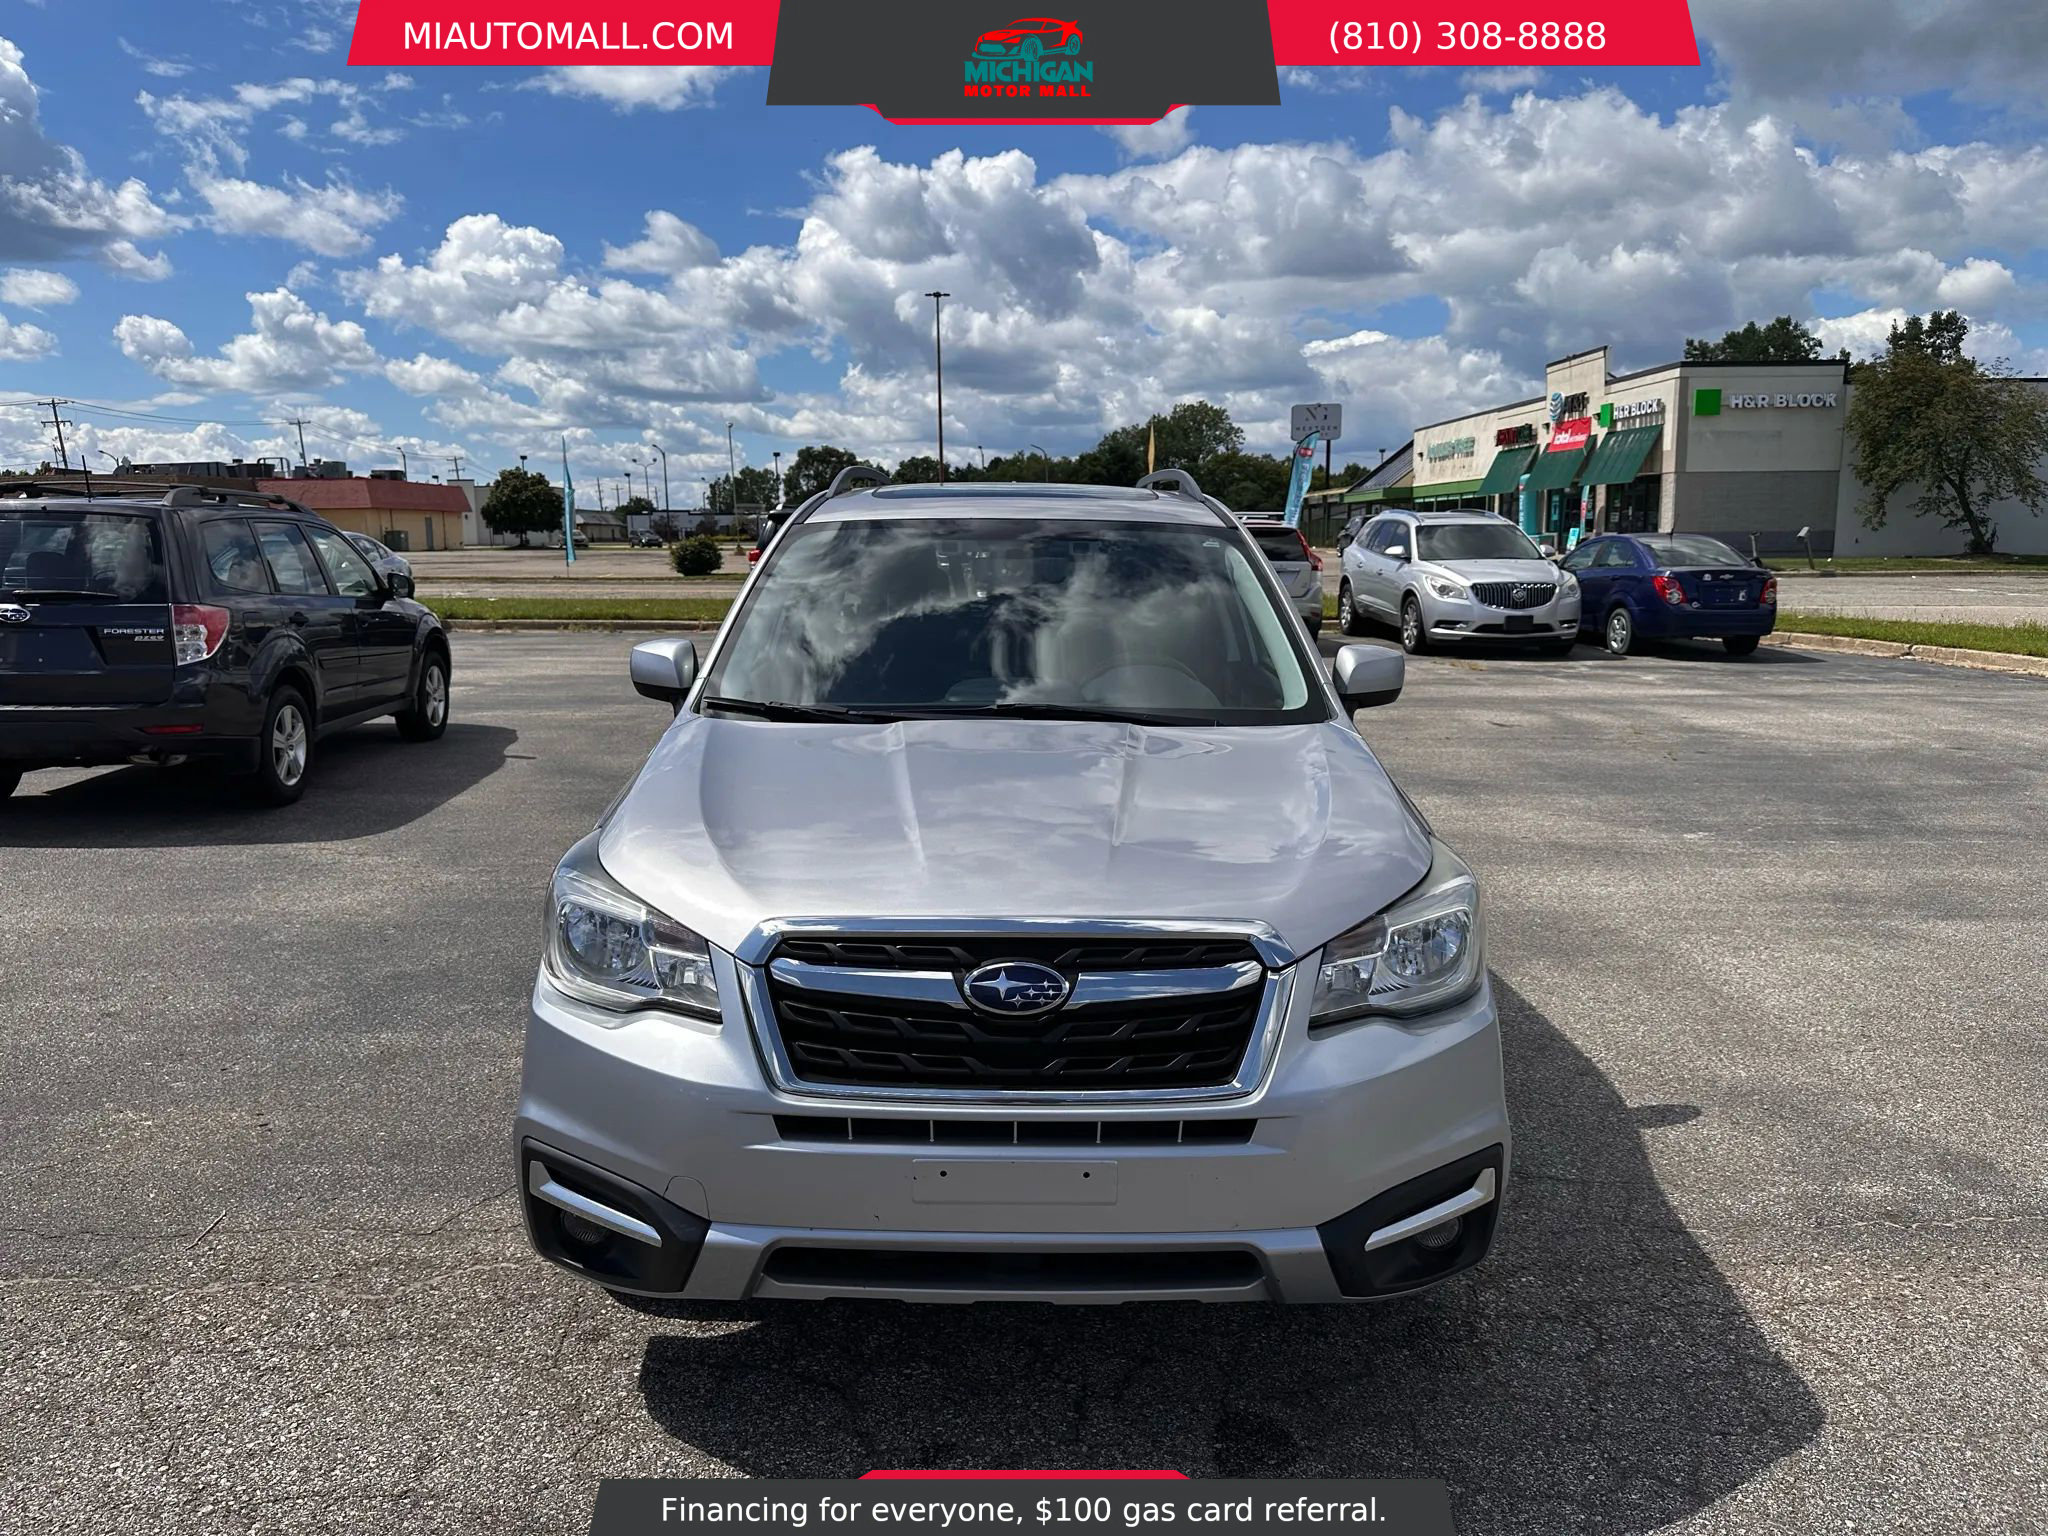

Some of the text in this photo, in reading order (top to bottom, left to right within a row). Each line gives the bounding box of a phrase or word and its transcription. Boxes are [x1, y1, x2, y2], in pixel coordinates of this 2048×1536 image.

[1614, 399, 1659, 420] H&R BLOCK
[1730, 392, 1838, 409] H&R BLOCK
